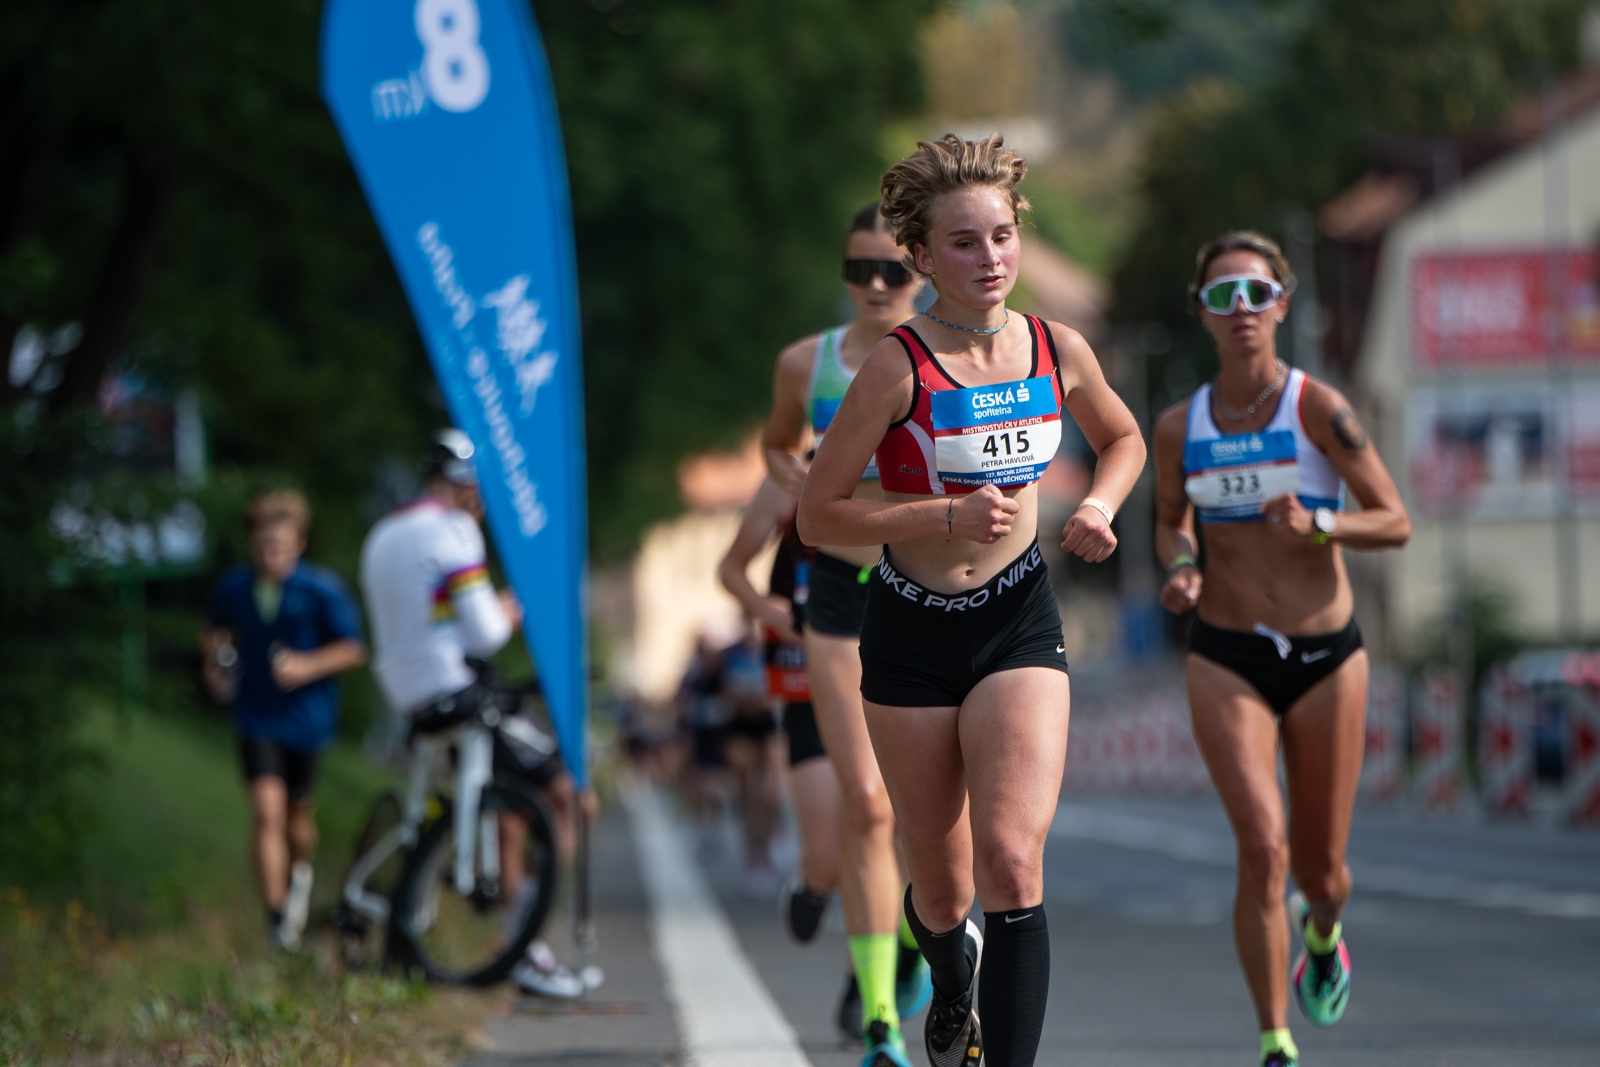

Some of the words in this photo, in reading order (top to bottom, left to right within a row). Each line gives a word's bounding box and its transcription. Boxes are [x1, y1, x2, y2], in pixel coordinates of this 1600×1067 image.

[972, 388, 1015, 409] ČESKÁ
[974, 406, 1012, 420] spořitelna
[962, 422, 1004, 435] MISTROVSTVÍ
[1004, 420, 1013, 429] ČR
[1018, 416, 1043, 428] ATLETICE
[982, 430, 1030, 458] 415
[981, 457, 1004, 469] PETRA
[1004, 454, 1035, 466] HAVLOVÁ
[942, 476, 962, 484] ČESKÁ
[963, 476, 1002, 486] SPOŘITELNA
[1003, 473, 1035, 484] BĚCHOVICE
[985, 470, 997, 478] 127.
[997, 468, 1015, 477] ROČNÍK
[1015, 466, 1035, 475] ZÁVODU
[1220, 475, 1260, 496] 323
[877, 556, 923, 602] NIKE
[924, 589, 989, 612] PRO
[997, 543, 1041, 596] NIKE
